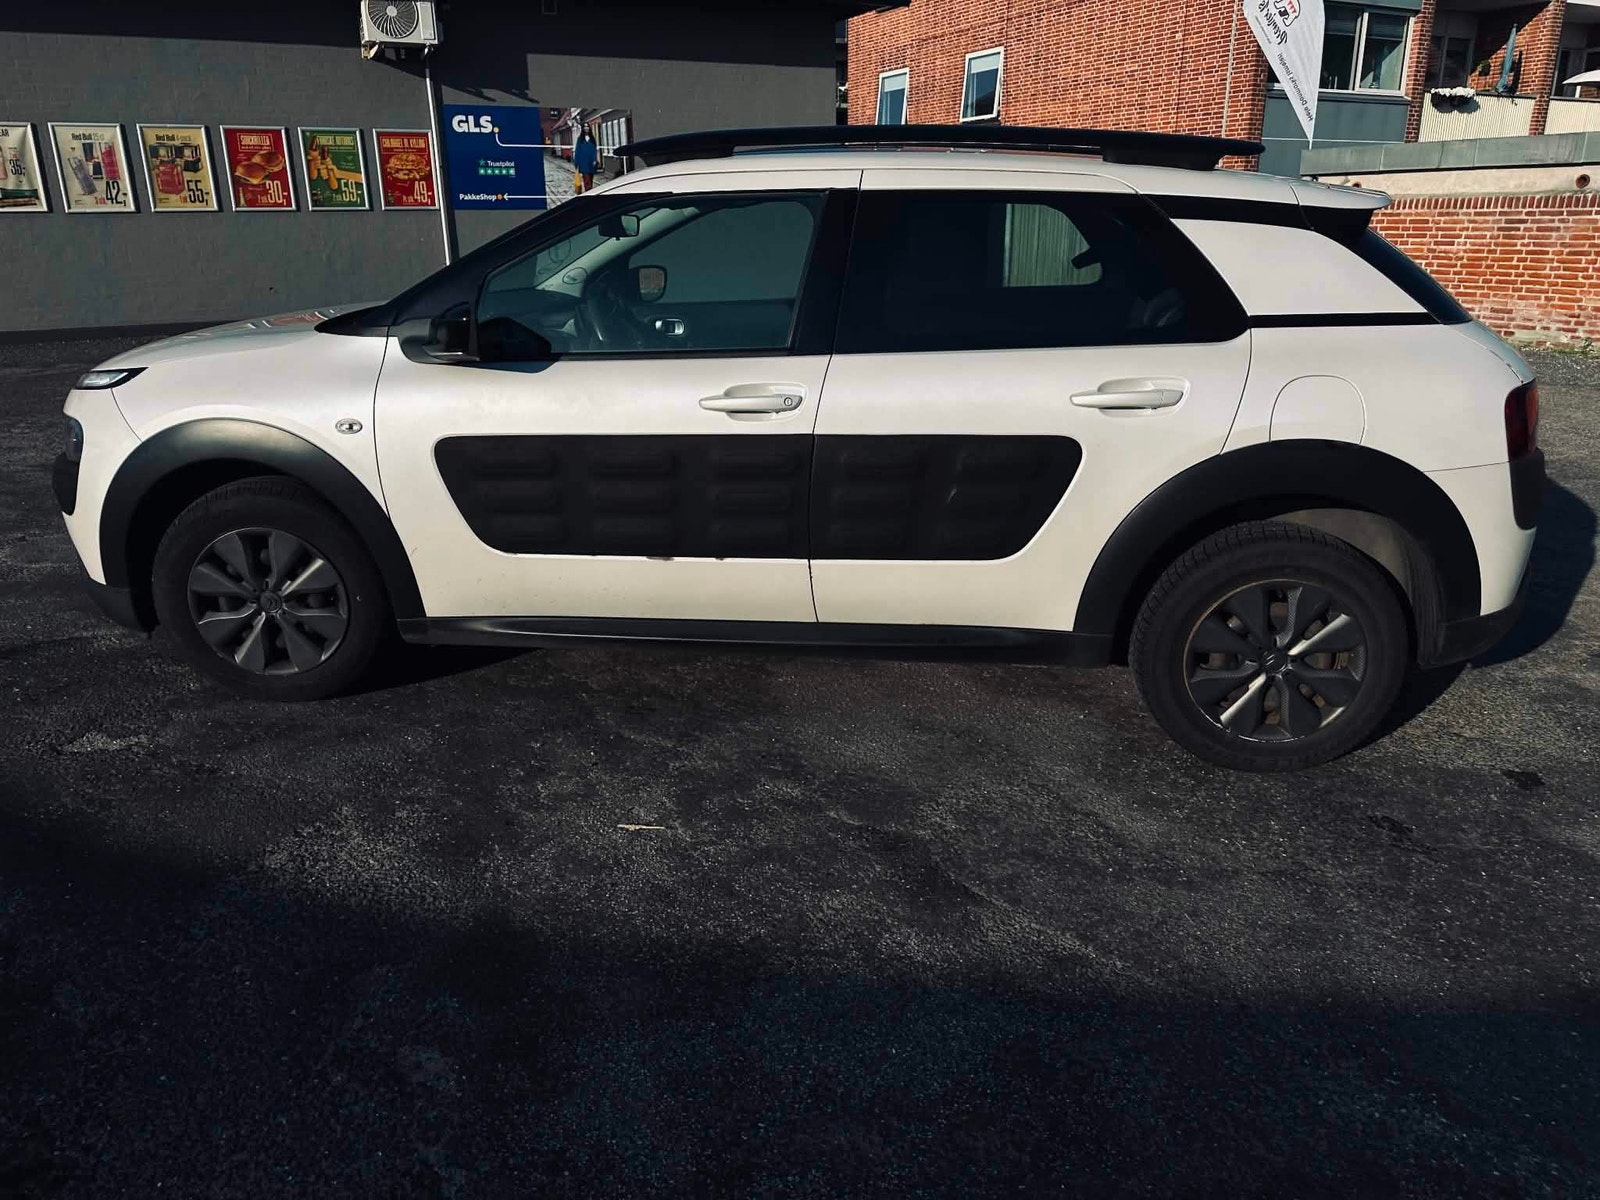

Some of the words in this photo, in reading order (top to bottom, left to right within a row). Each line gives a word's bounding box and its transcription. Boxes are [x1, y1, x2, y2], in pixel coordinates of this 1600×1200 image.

[71, 133, 81, 141] Red
[82, 133, 92, 141] Bull
[155, 134, 165, 142] Red
[166, 134, 176, 142] Bull
[487, 160, 515, 168] Trustpilot
[459, 193, 497, 202] PakkeShop
